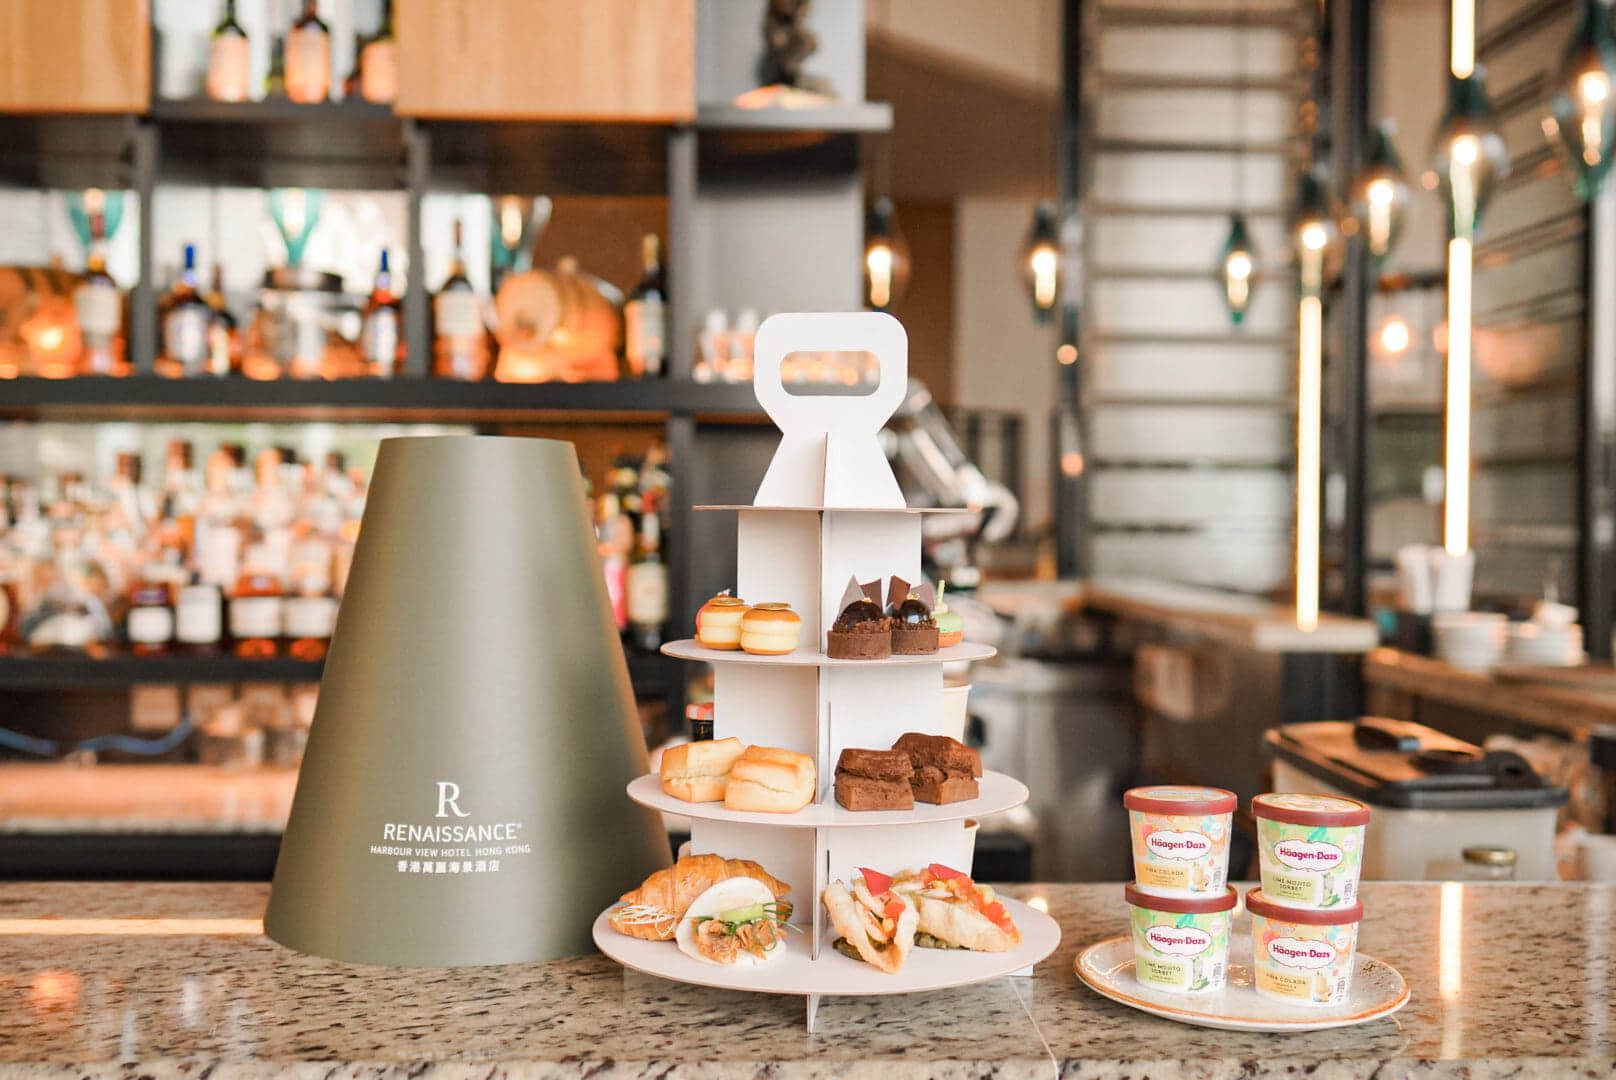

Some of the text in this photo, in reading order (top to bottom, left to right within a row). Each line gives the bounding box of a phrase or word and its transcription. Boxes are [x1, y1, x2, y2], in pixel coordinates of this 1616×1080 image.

[435, 781, 471, 818] R
[383, 824, 518, 842] RENAISSANCE
[370, 844, 532, 857] HARBOUR VIEW HOTEL HONG KONG
[1151, 838, 1206, 850] Häagen-Dazs
[1280, 847, 1338, 861] Häagen-Dazs
[1150, 933, 1206, 945] Häagen-Dazs
[1272, 944, 1331, 958] Häagen-Dazs
